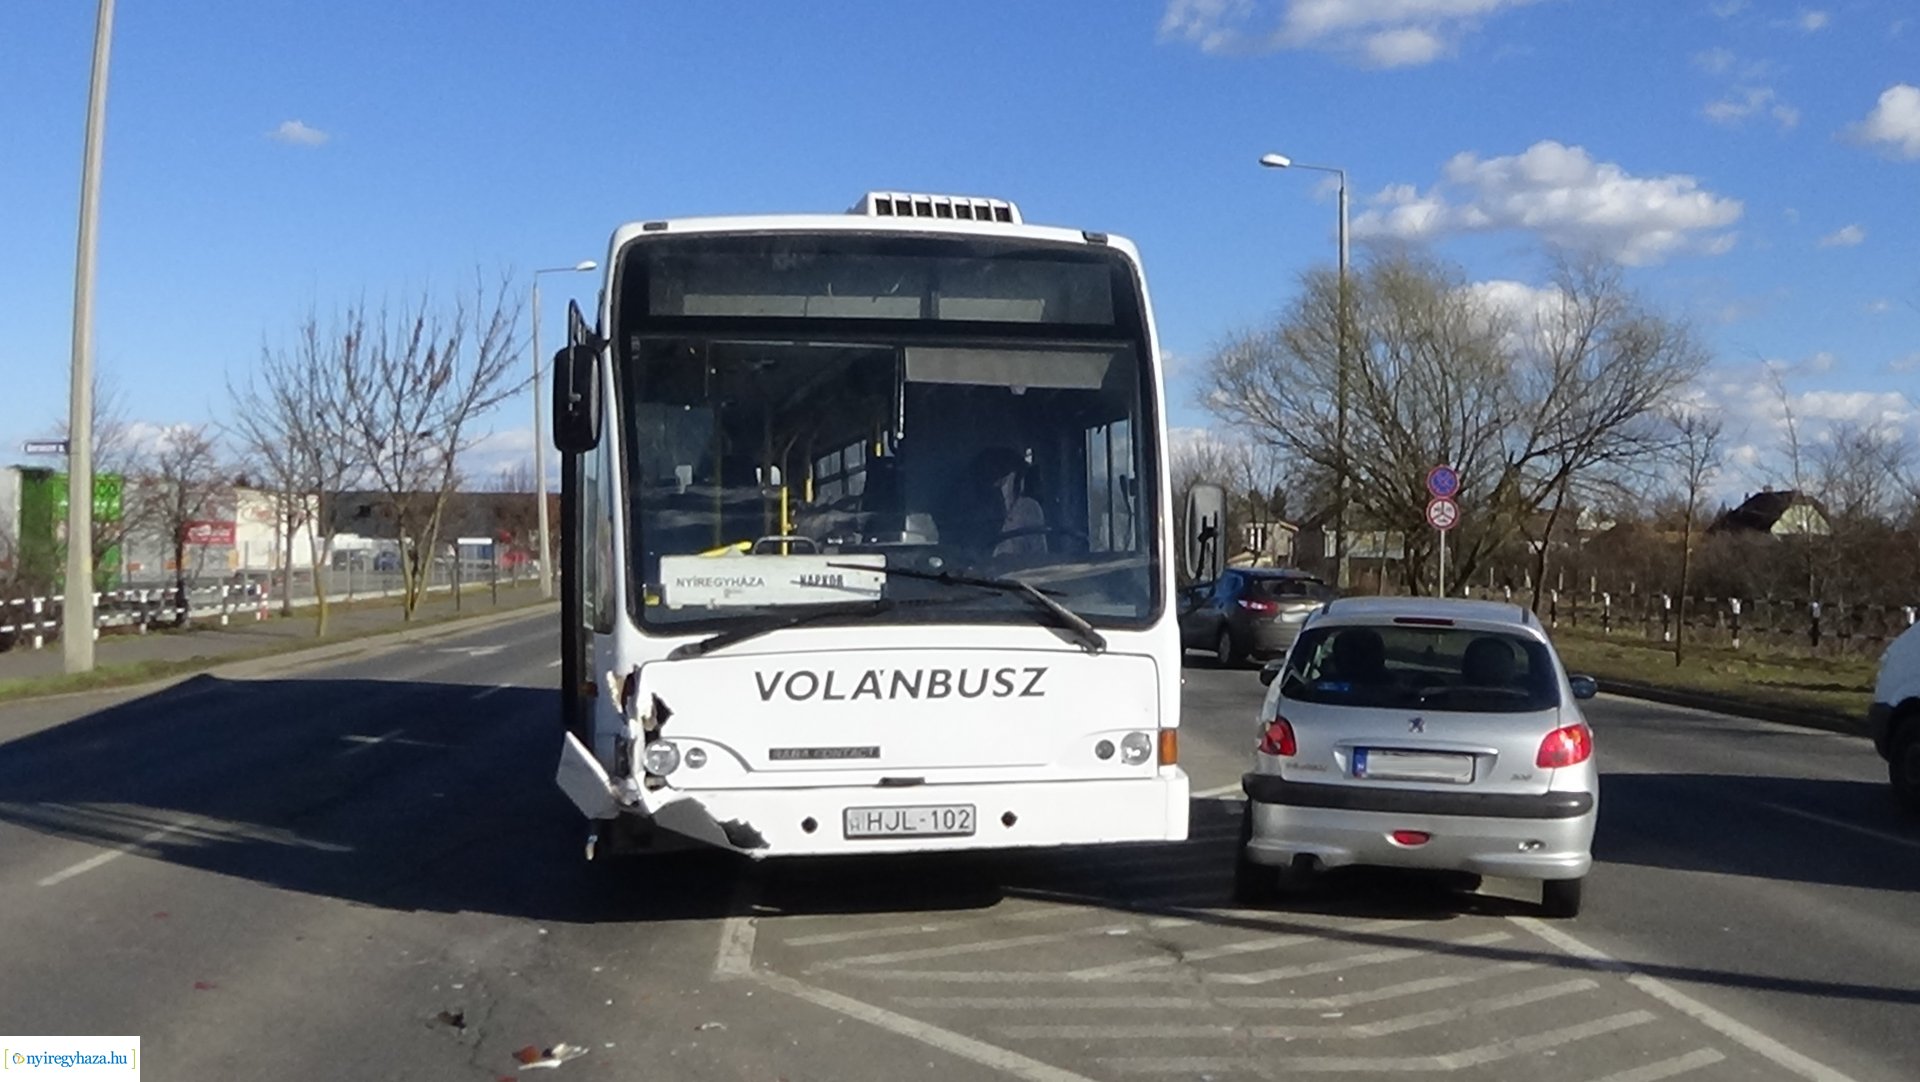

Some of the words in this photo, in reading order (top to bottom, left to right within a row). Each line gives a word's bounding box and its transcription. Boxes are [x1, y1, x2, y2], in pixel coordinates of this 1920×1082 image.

[676, 575, 765, 587] NYÍREGYHÁZA
[754, 667, 1048, 701] VOLÁNBUSZ
[867, 809, 970, 831] HJL-102
